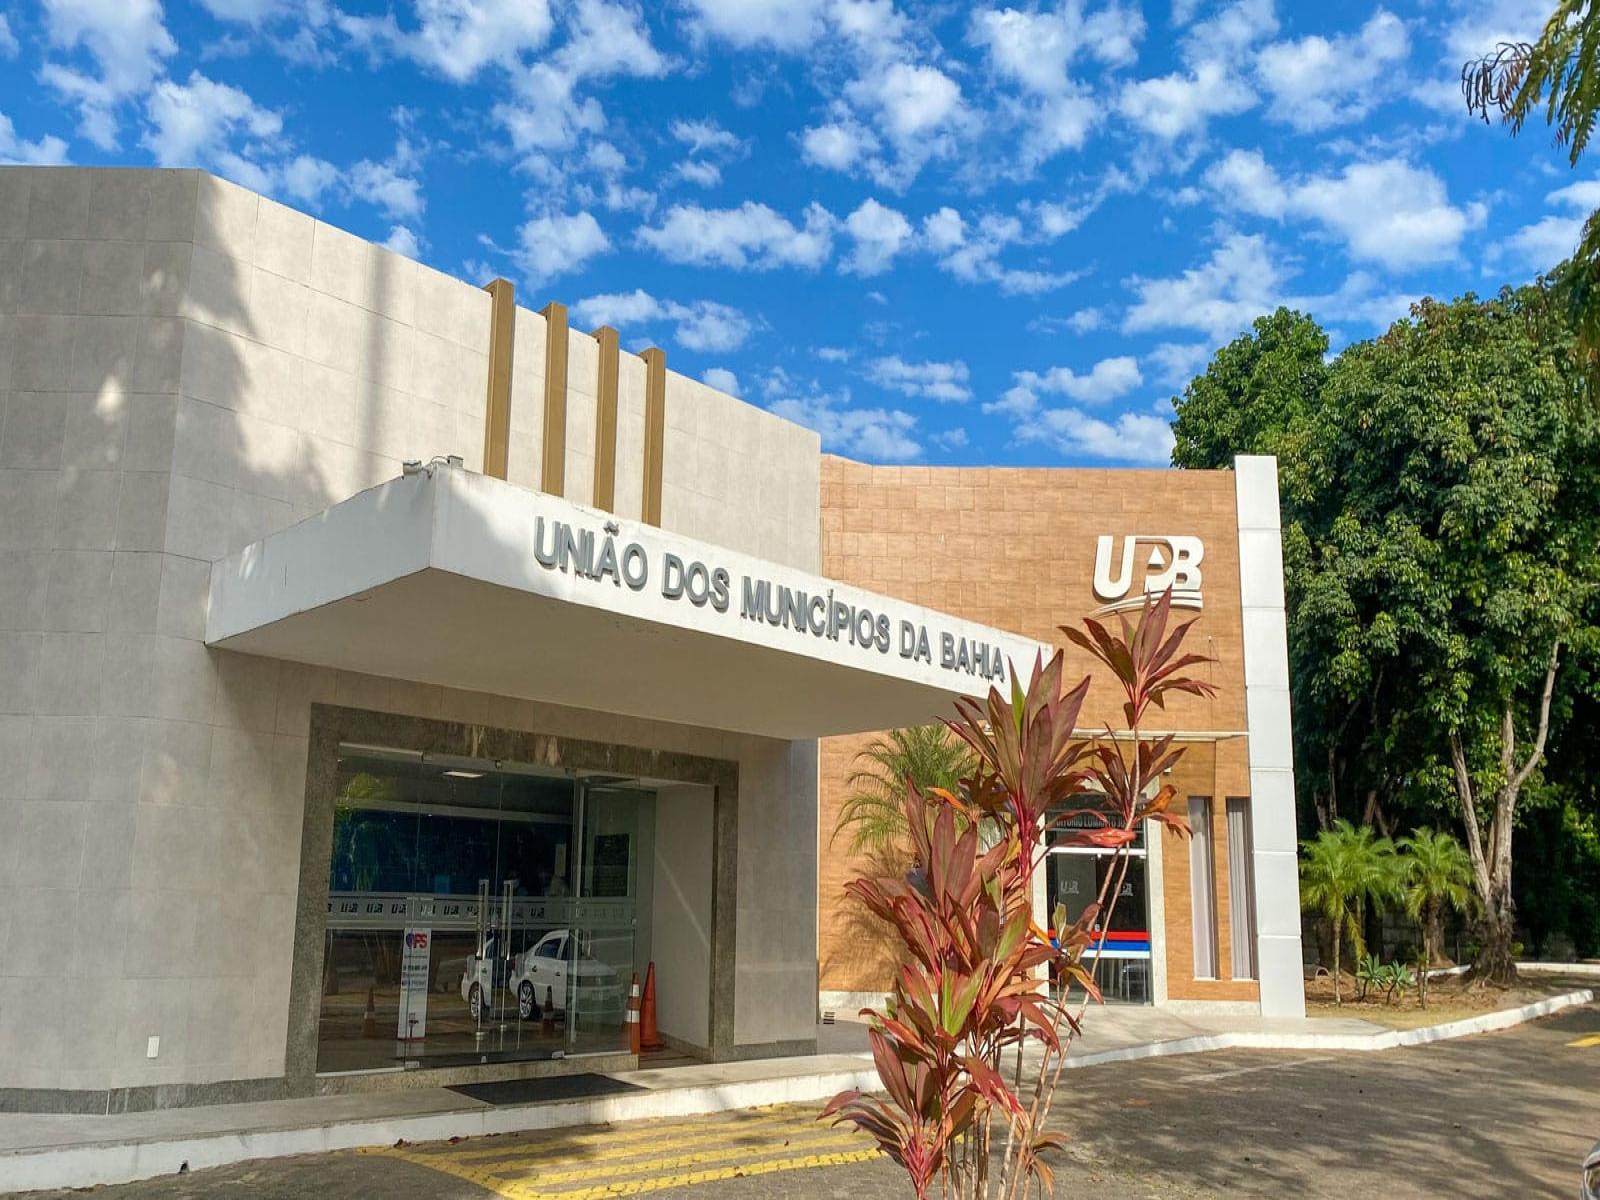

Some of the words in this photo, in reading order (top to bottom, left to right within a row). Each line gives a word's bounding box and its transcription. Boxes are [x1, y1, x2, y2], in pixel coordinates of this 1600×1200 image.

[534, 515, 648, 592] UNIÃO
[661, 552, 730, 613] DOS
[740, 575, 890, 653] MUNICÍPIOS
[899, 619, 932, 665] DA
[939, 631, 1005, 682] BAHIA
[1092, 535, 1204, 601] UPB
